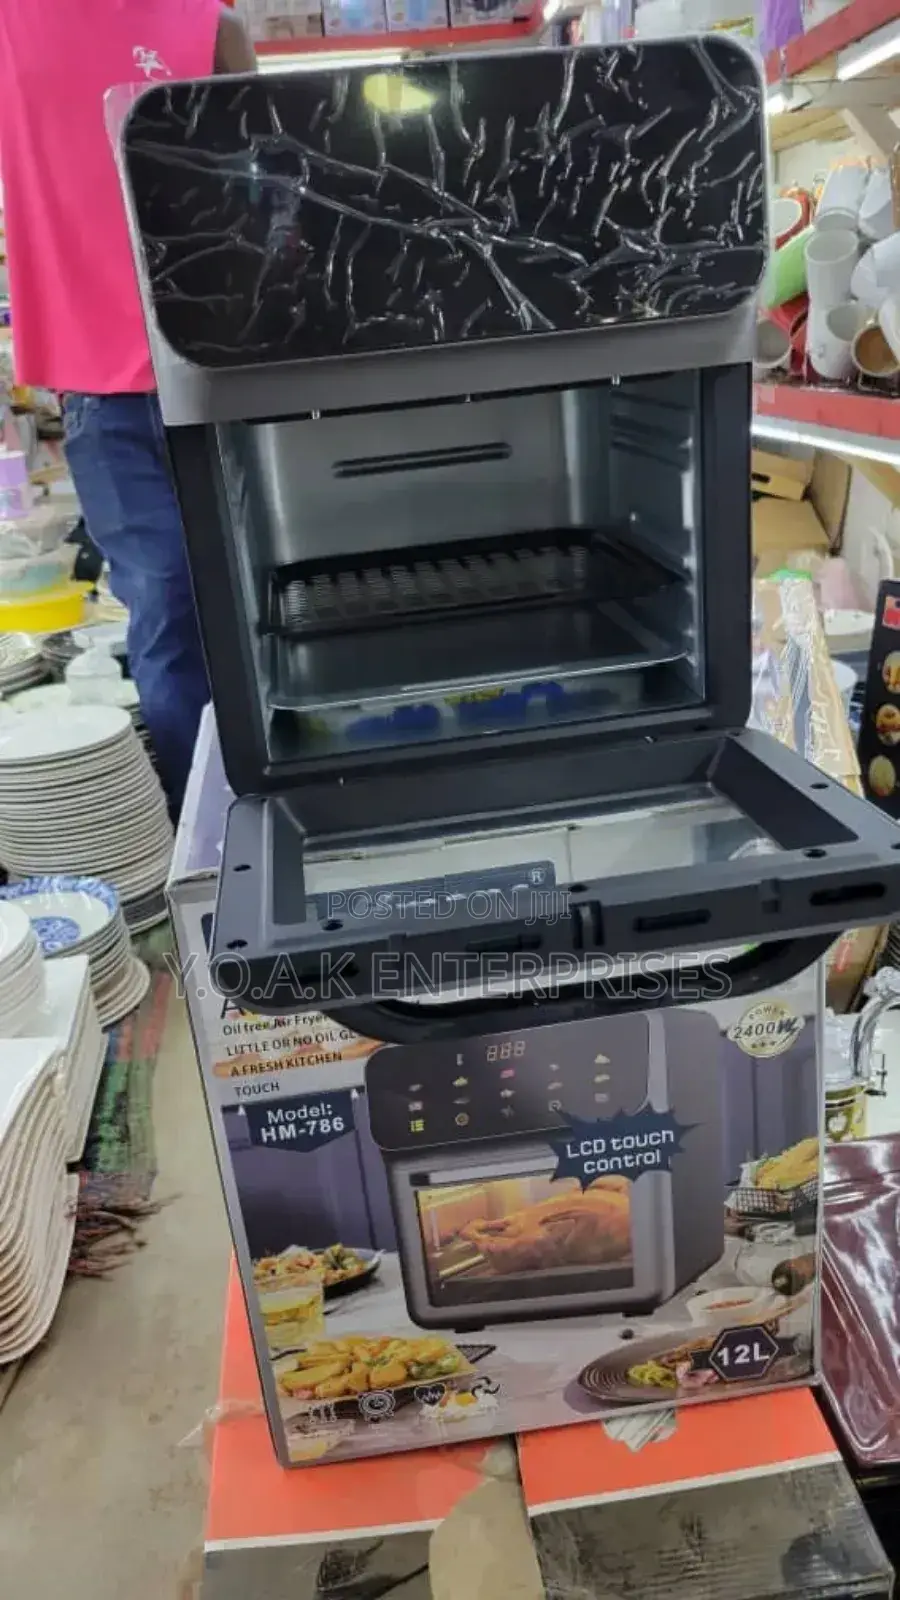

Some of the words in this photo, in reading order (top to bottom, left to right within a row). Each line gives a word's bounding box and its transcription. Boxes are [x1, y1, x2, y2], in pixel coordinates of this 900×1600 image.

[223, 1022, 241, 1036] Oil
[733, 1017, 799, 1039] 2400W
[226, 1039, 271, 1056] LITTLE
[272, 1038, 291, 1050] OR
[293, 1034, 313, 1047] NO
[315, 1030, 337, 1044] OIL
[241, 1060, 284, 1076] FRESH
[286, 1051, 343, 1067] KITCHEN
[234, 1081, 280, 1098] TOUCH
[266, 1103, 333, 1125] Model:
[261, 1116, 345, 1143] HM-786
[566, 1138, 606, 1158] LCD
[610, 1129, 674, 1151] touch
[583, 1149, 661, 1174] control
[717, 1342, 770, 1366] 12L
